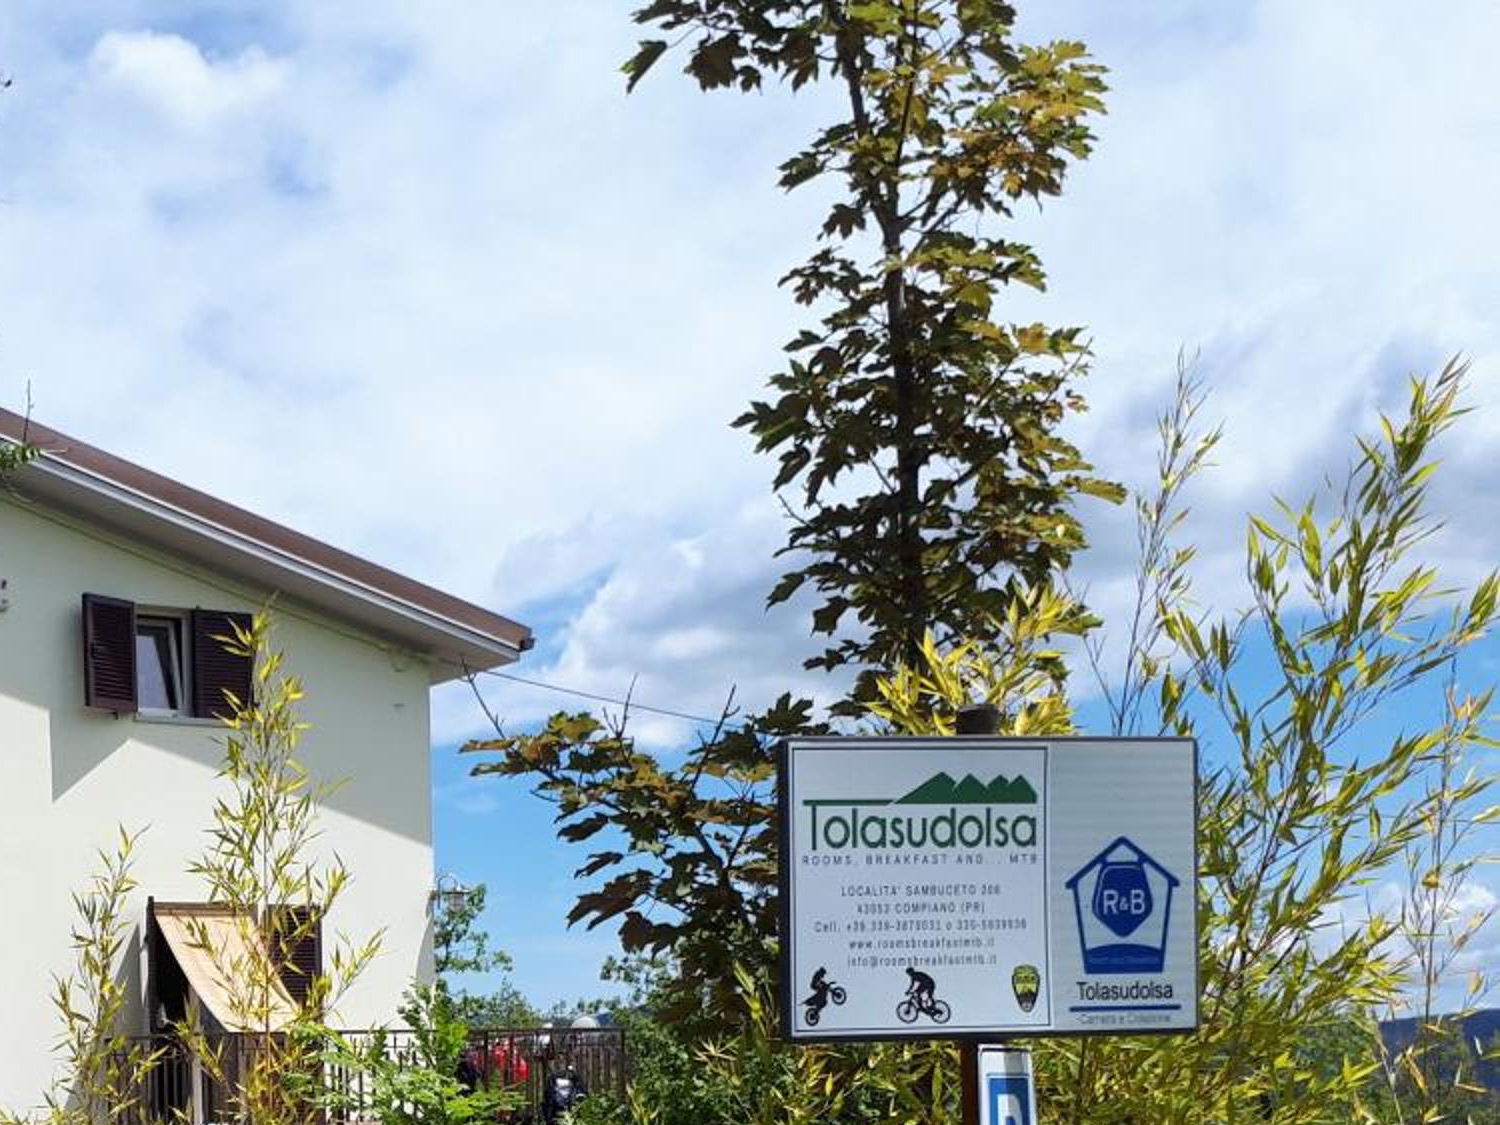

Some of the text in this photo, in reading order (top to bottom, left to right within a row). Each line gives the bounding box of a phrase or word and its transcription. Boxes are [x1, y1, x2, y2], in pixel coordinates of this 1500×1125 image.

[803, 803, 1037, 851] Tolasudolsa
[865, 853, 947, 865] BREAKFAST
[1009, 853, 1038, 865] MTB
[905, 884, 976, 897] SAMBUCETO
[894, 902, 956, 915] COMPIANO
[960, 901, 986, 915] (PR)
[1103, 889, 1145, 915] R&B
[847, 920, 866, 932] +39
[1076, 981, 1173, 1001] Tolasudolsa
